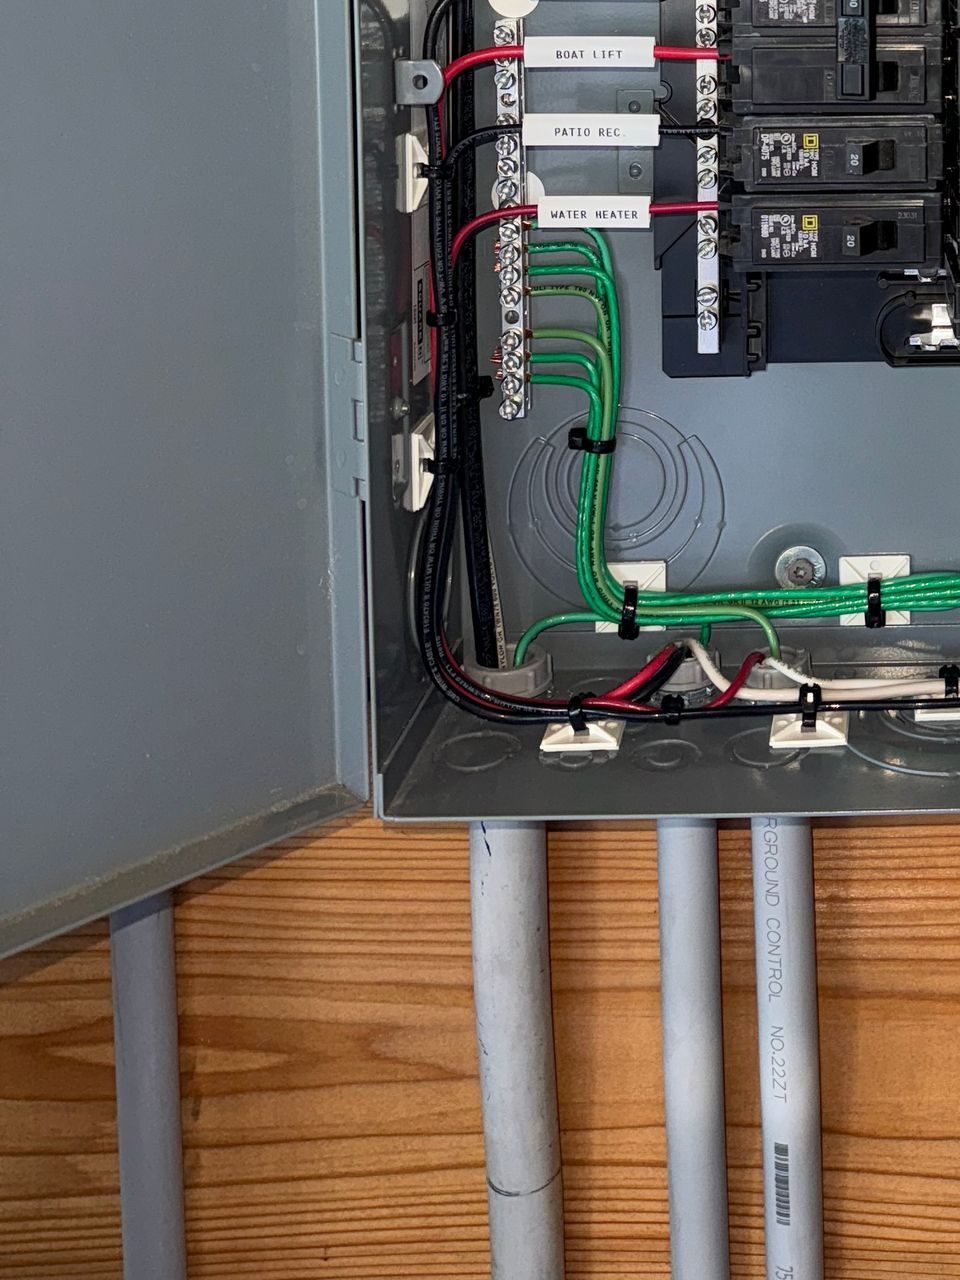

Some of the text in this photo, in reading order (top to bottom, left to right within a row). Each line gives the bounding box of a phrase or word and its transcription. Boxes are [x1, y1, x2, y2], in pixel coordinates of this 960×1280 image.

[556, 50, 623, 59] BOAT LIFT
[554, 127, 591, 137] PATIO
[761, 134, 769, 160] DP-4075
[850, 153, 859, 167] 20
[550, 210, 638, 220] WATER HEATER
[846, 235, 855, 248] 20
[766, 917, 783, 1003] CONTROL
